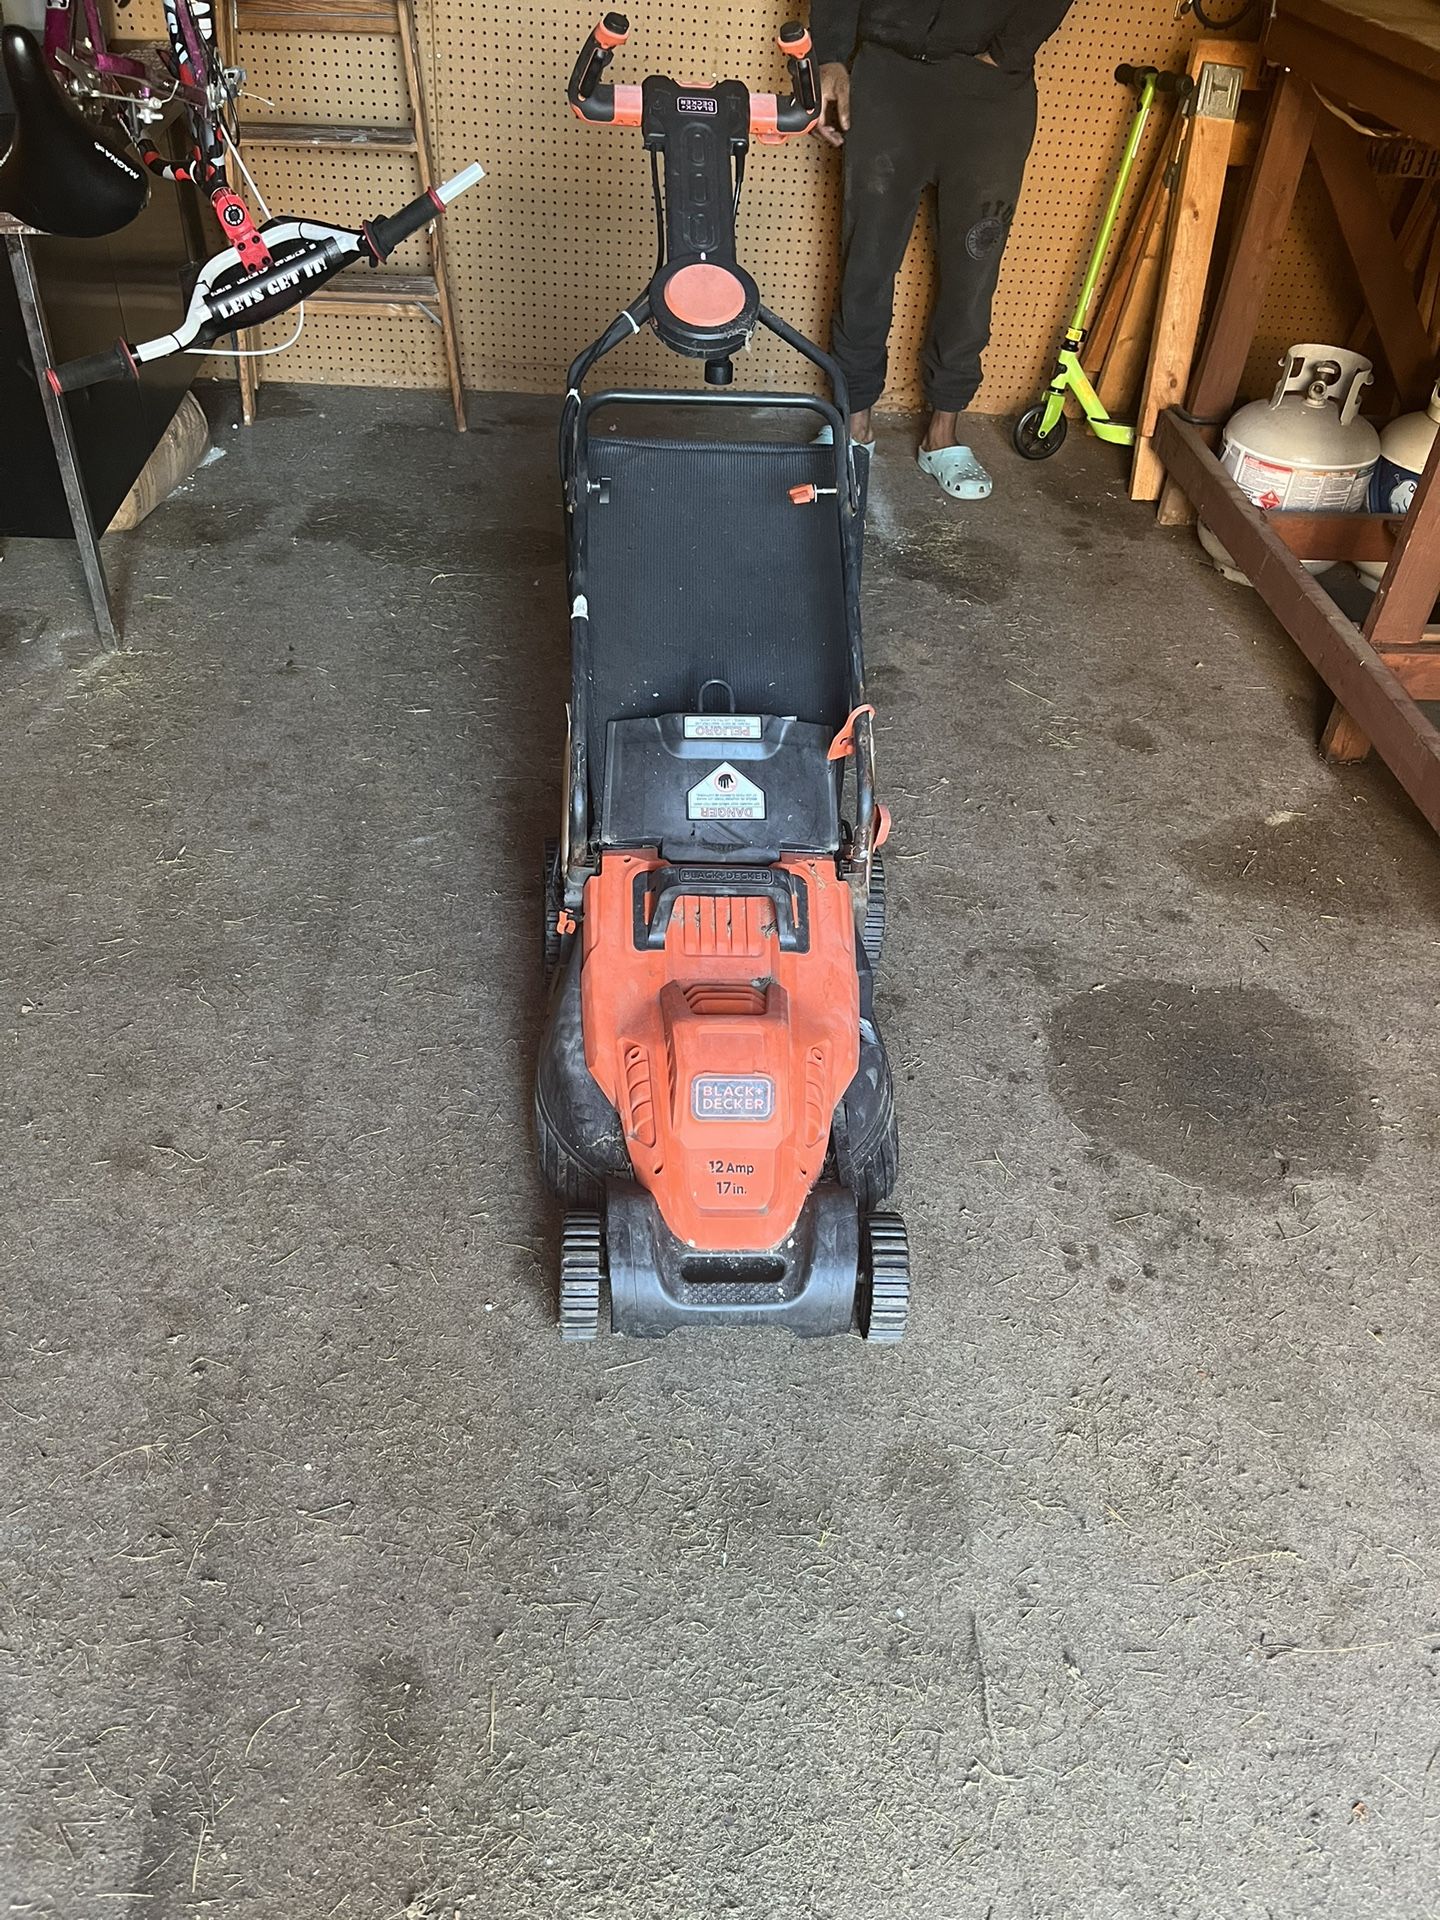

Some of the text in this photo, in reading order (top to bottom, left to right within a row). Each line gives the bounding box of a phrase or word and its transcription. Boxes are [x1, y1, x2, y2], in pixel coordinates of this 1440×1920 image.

[681, 104, 714, 112] BLACK+
[217, 289, 265, 319] LETS
[267, 270, 301, 296] GET
[303, 257, 328, 279] IT!
[695, 726, 751, 736] PELIGRO
[700, 807, 753, 818] DANGER
[703, 1086, 764, 1097] BLACK+
[703, 1098, 764, 1110] DECKER
[709, 1160, 754, 1175] 12 Amp
